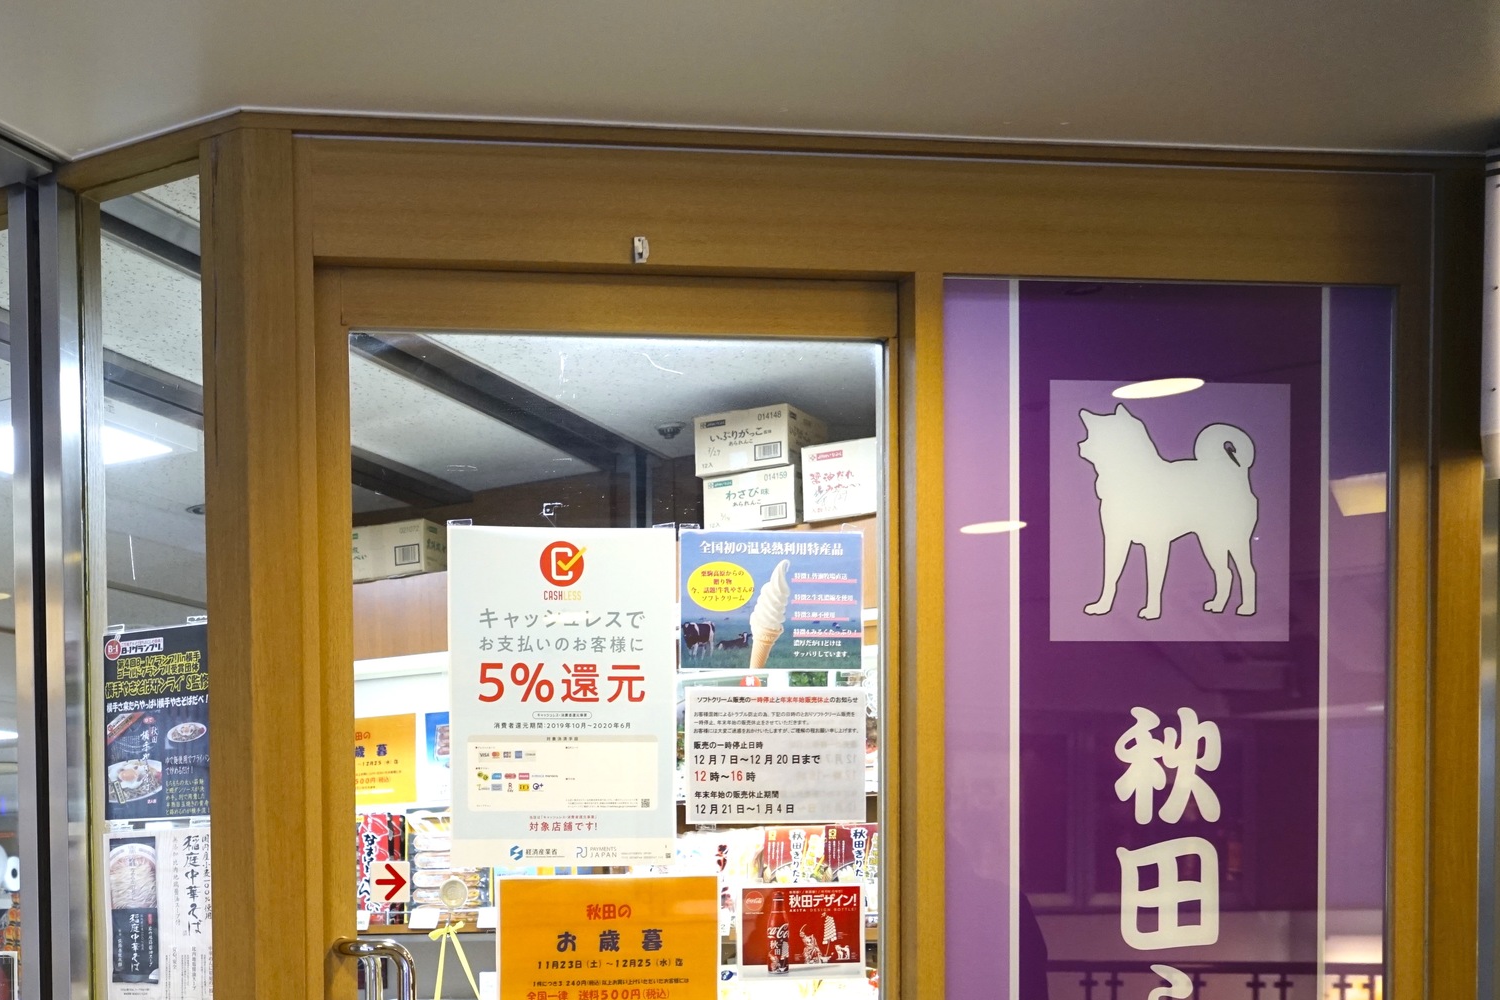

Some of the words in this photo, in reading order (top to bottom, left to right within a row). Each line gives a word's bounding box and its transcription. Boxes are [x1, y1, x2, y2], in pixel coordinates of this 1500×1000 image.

[757, 410, 782, 421] 014148
[764, 471, 788, 482] 014159
[699, 541, 844, 556] 全国初の温泉熱利用特産品
[543, 590, 582, 600] CASHLESS
[479, 635, 644, 653] お支払いのお客様に
[478, 662, 646, 703] 5%還元
[693, 741, 764, 749] 販売の一時停止日時
[694, 790, 780, 799] 年末年始の販売休止期間
[526, 848, 558, 856] 経済産業省
[183, 835, 203, 937] 稲庭中華そば
[789, 893, 858, 908] 秋田デザイン!
[586, 904, 632, 920] 秋田の
